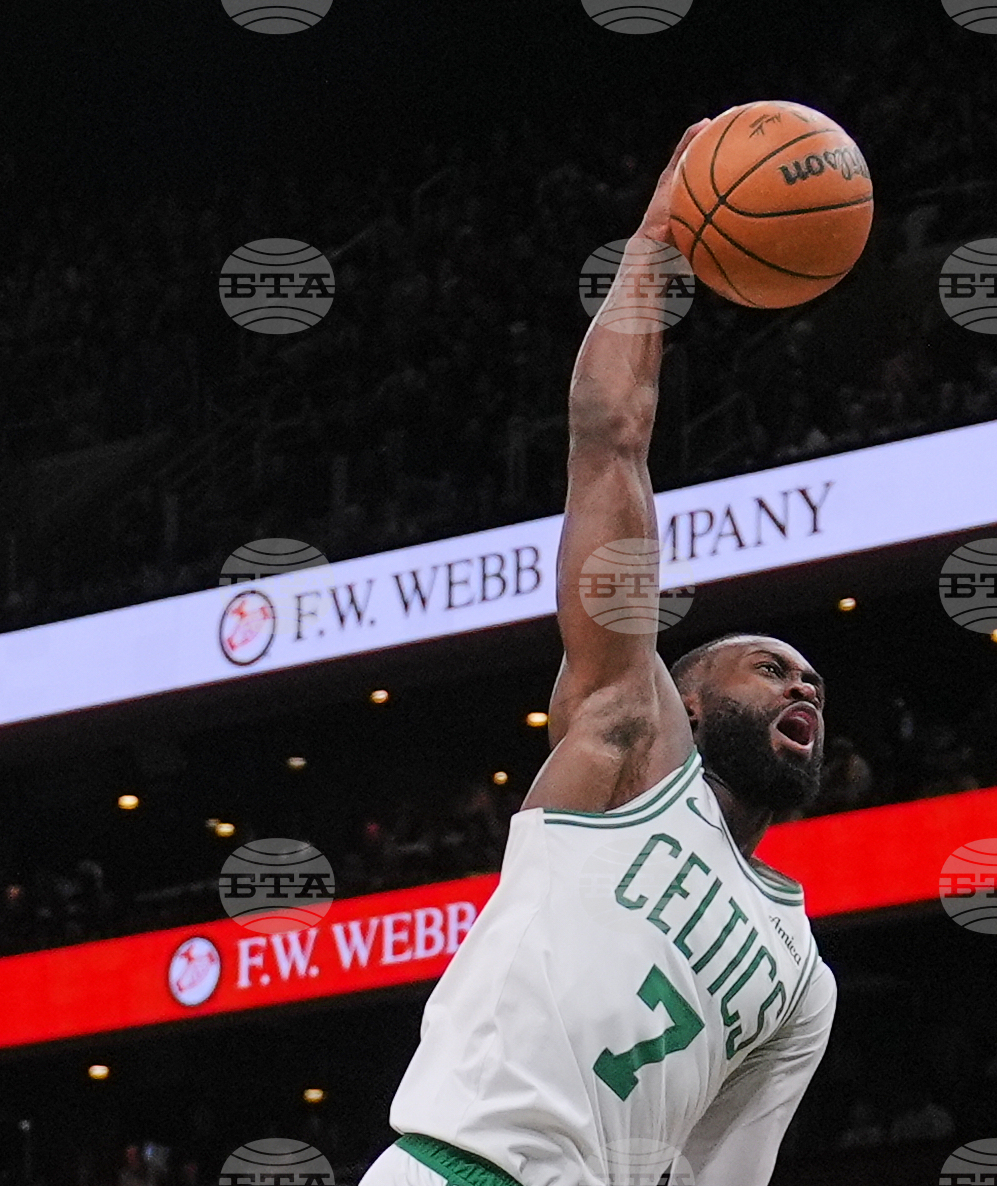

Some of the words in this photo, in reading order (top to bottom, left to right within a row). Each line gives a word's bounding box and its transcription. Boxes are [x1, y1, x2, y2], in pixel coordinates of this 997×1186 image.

[294, 578, 376, 641] F.W.
[393, 546, 541, 618] WEBB
[237, 928, 320, 989] F.W.
[332, 901, 478, 970] WEBB
[614, 832, 787, 1060] CELTICS
[769, 915, 801, 966] Amica
[593, 964, 705, 1101] 7
